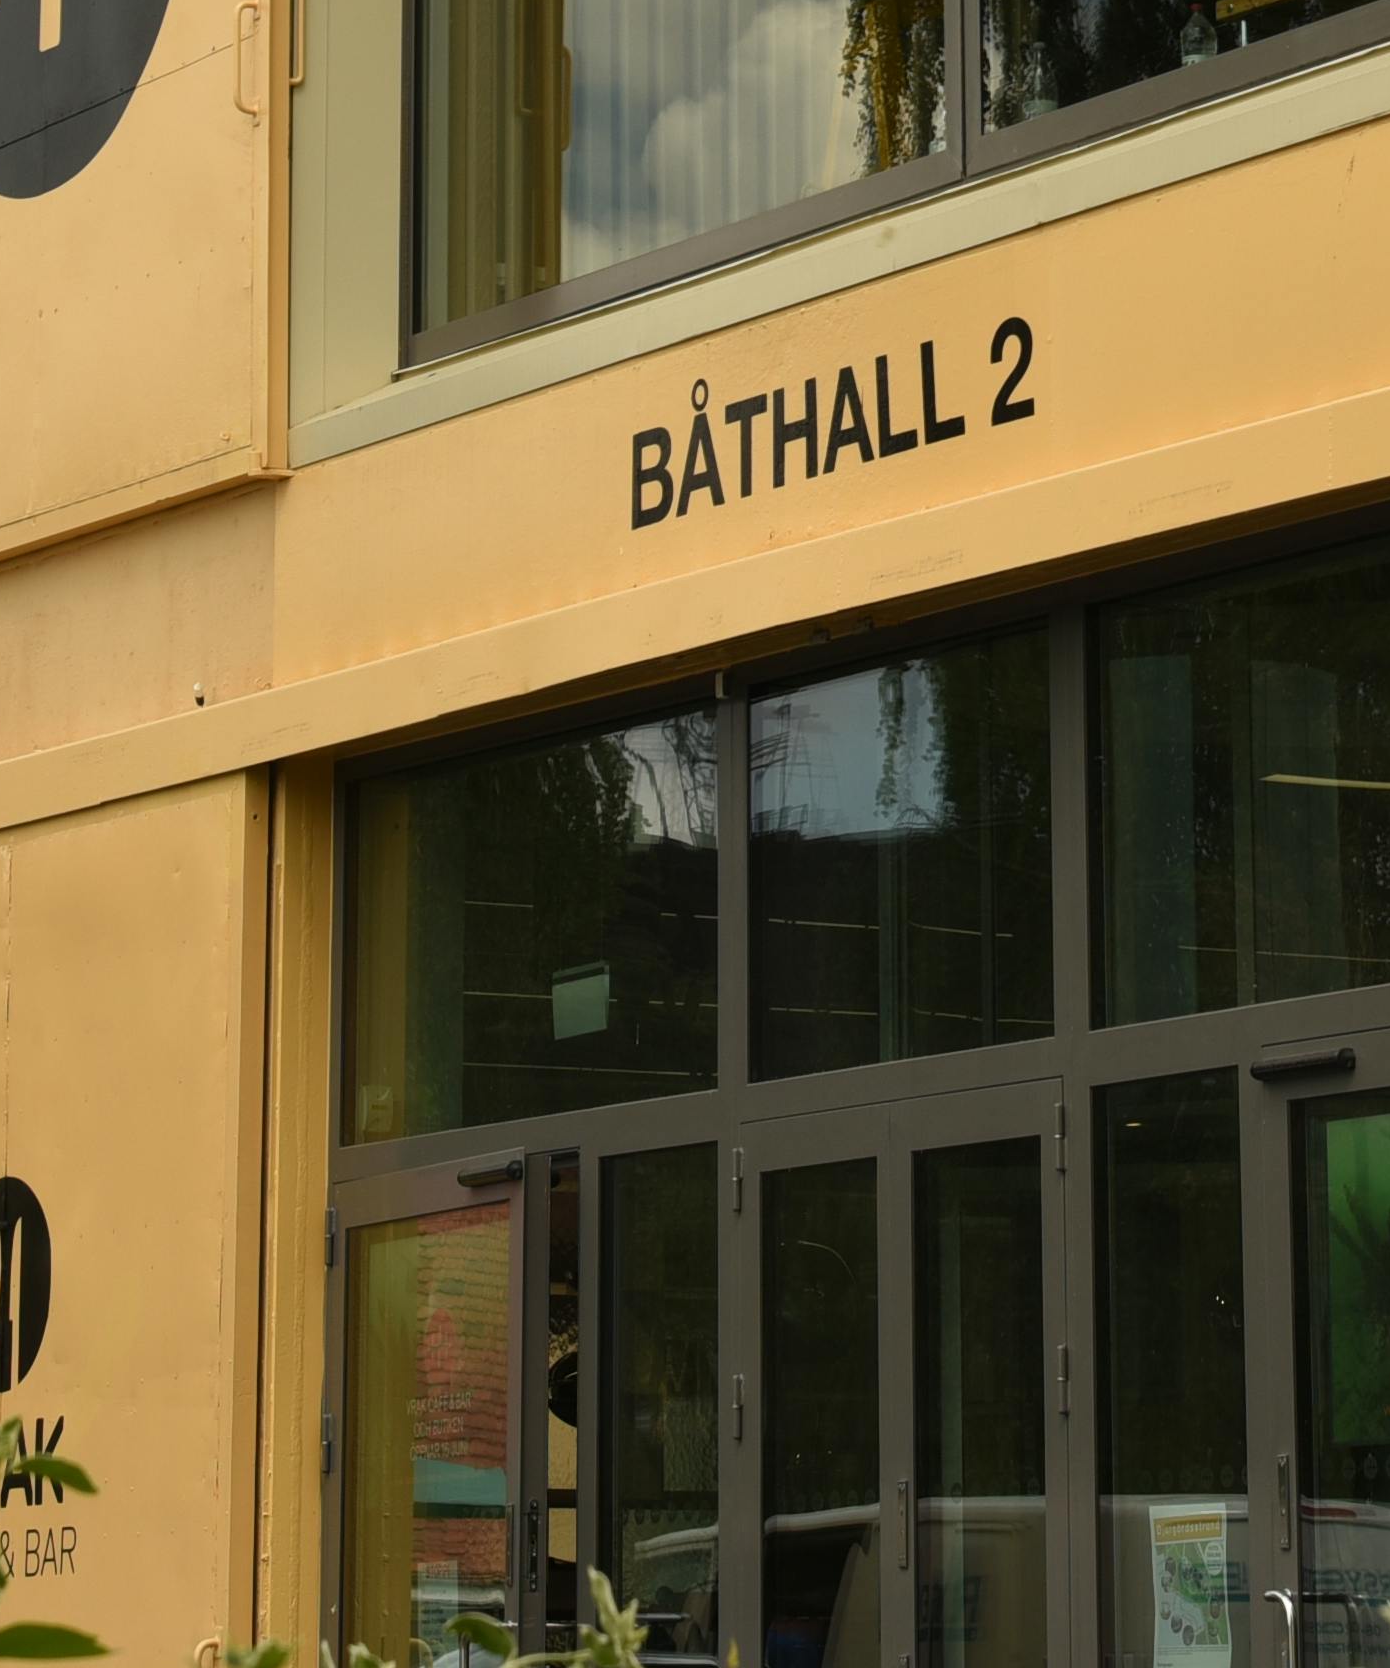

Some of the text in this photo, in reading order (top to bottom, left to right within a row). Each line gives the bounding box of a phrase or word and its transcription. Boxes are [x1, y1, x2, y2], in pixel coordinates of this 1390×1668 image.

[631, 316, 1035, 530] BÅTHALL 2
[0, 1530, 15, 1578] &
[25, 1526, 77, 1577] BAR
